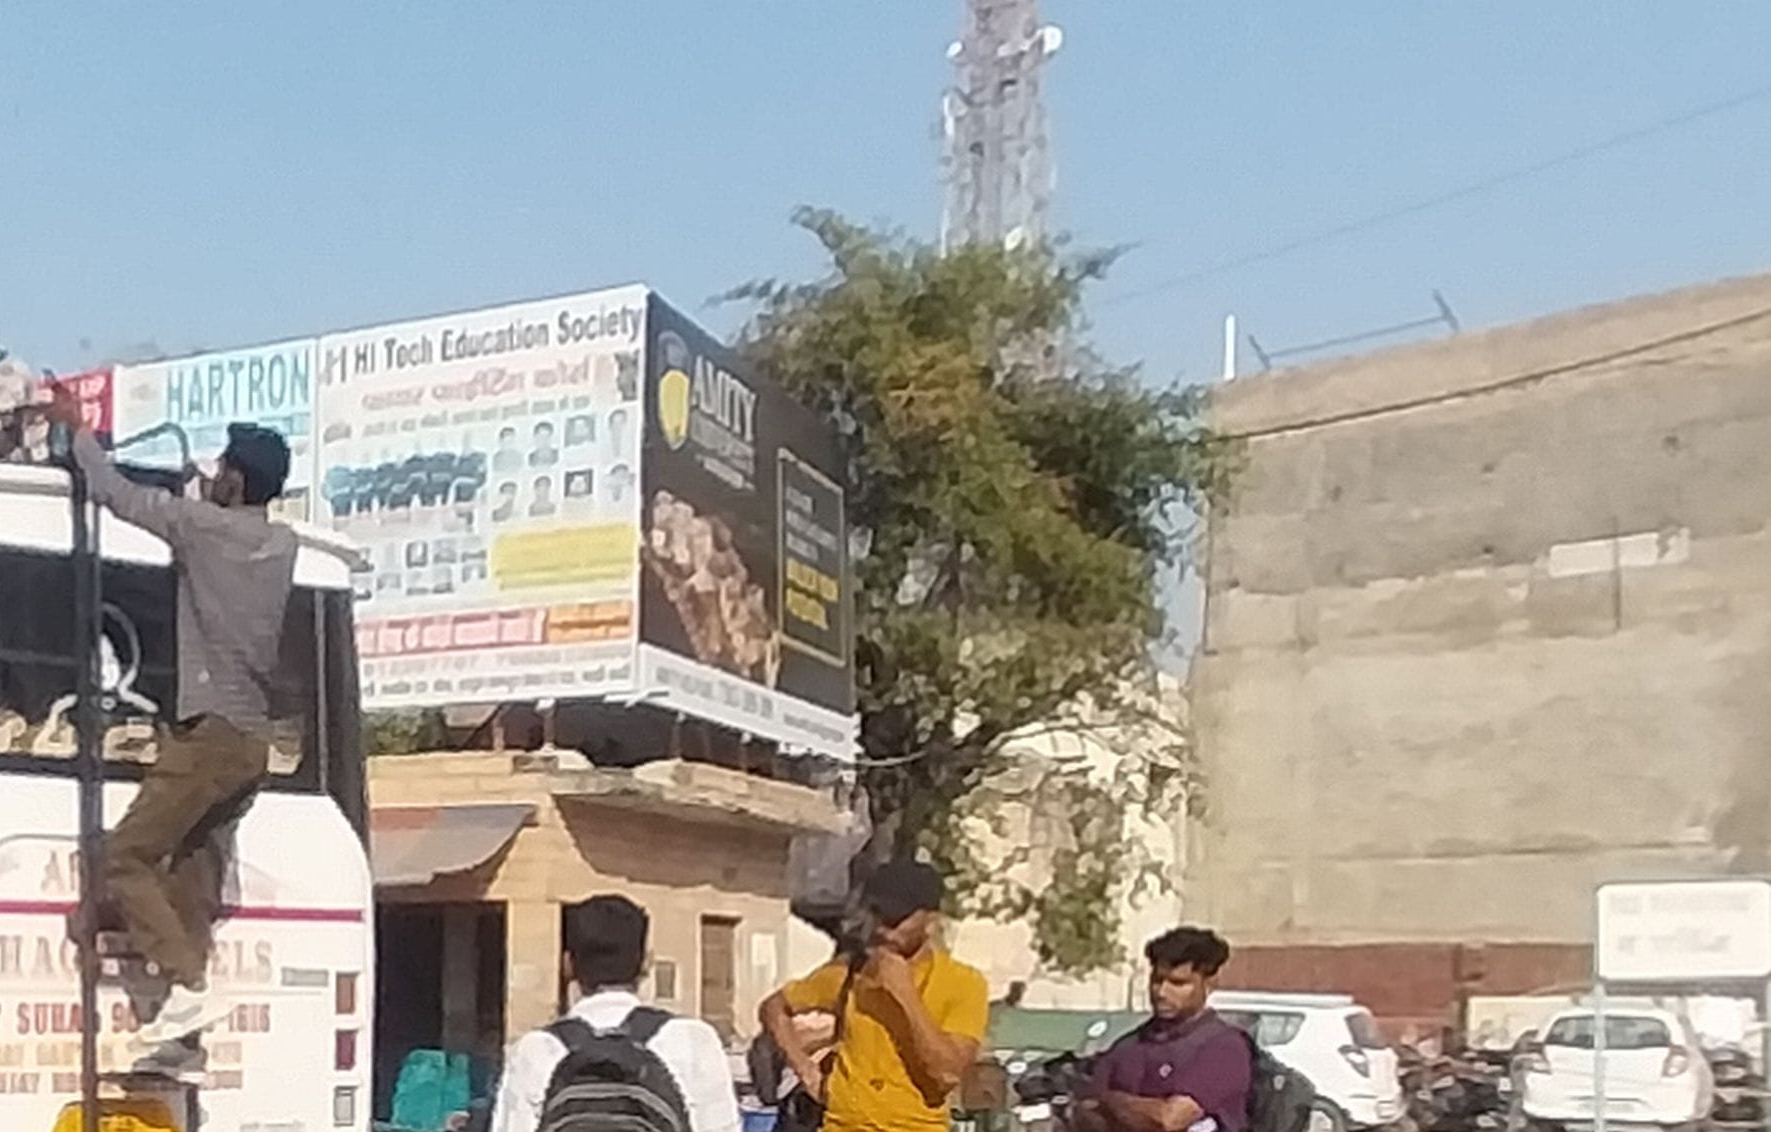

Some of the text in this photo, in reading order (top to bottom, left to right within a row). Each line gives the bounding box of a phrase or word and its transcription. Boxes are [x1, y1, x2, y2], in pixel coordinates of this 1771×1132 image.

[441, 319, 550, 362] Education
[557, 303, 643, 345] Society
[166, 348, 310, 422] HARTRON
[692, 355, 758, 442] AMITY
[17, 1002, 101, 1035] SUHA
